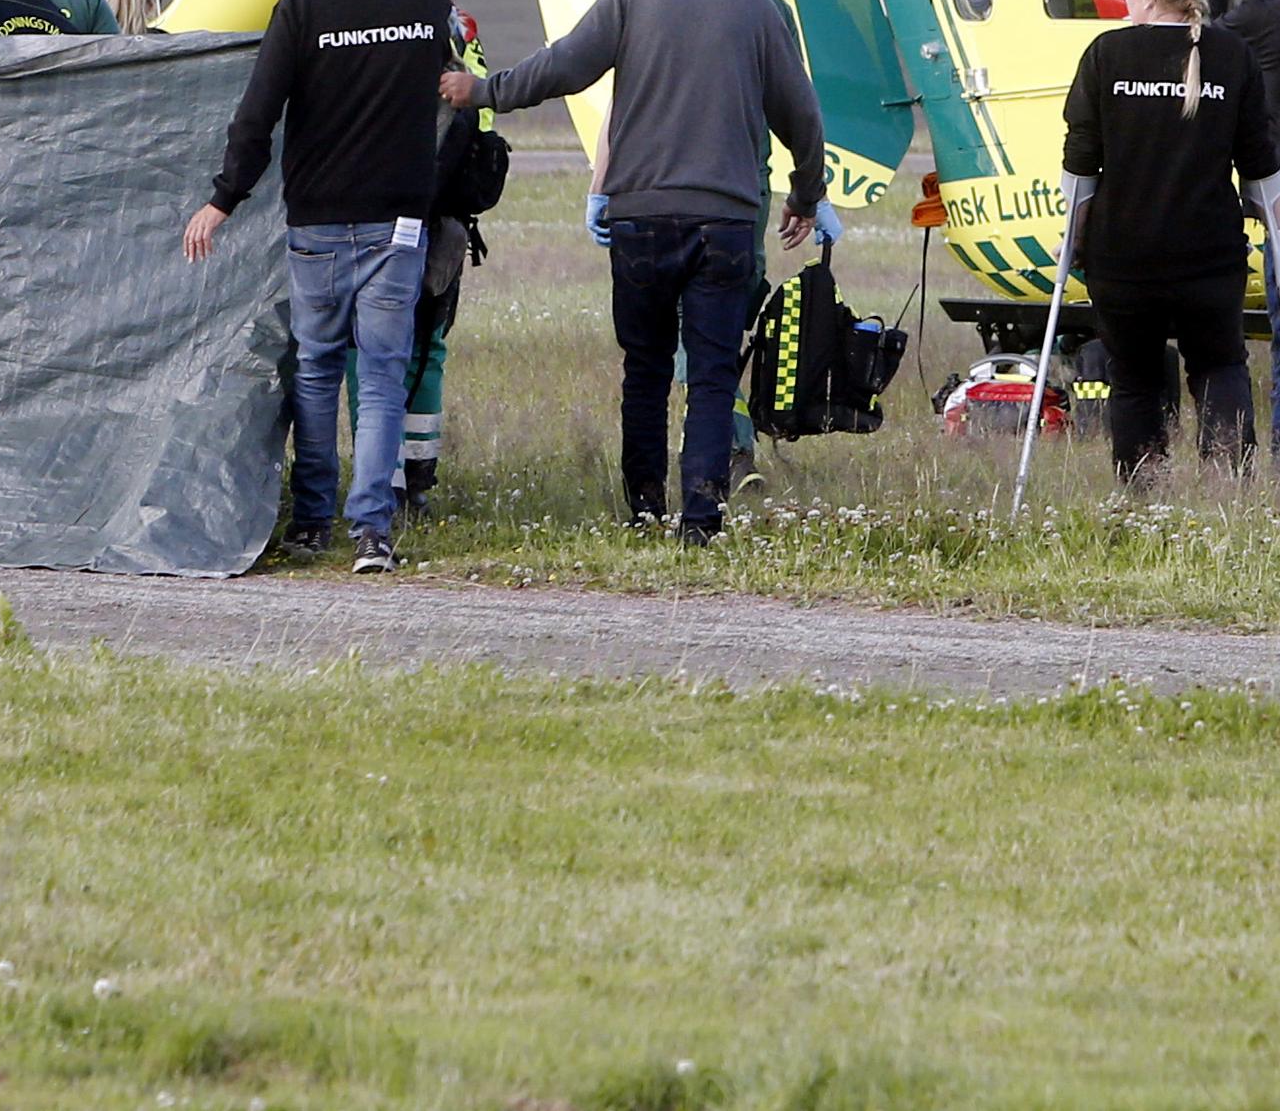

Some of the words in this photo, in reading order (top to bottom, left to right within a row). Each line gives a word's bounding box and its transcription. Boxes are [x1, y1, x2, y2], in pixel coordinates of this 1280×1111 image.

[319, 22, 434, 49] FUNKTIONÄR
[1113, 81, 1224, 100] FUNKTIOÄR
[947, 186, 990, 228] nsk
